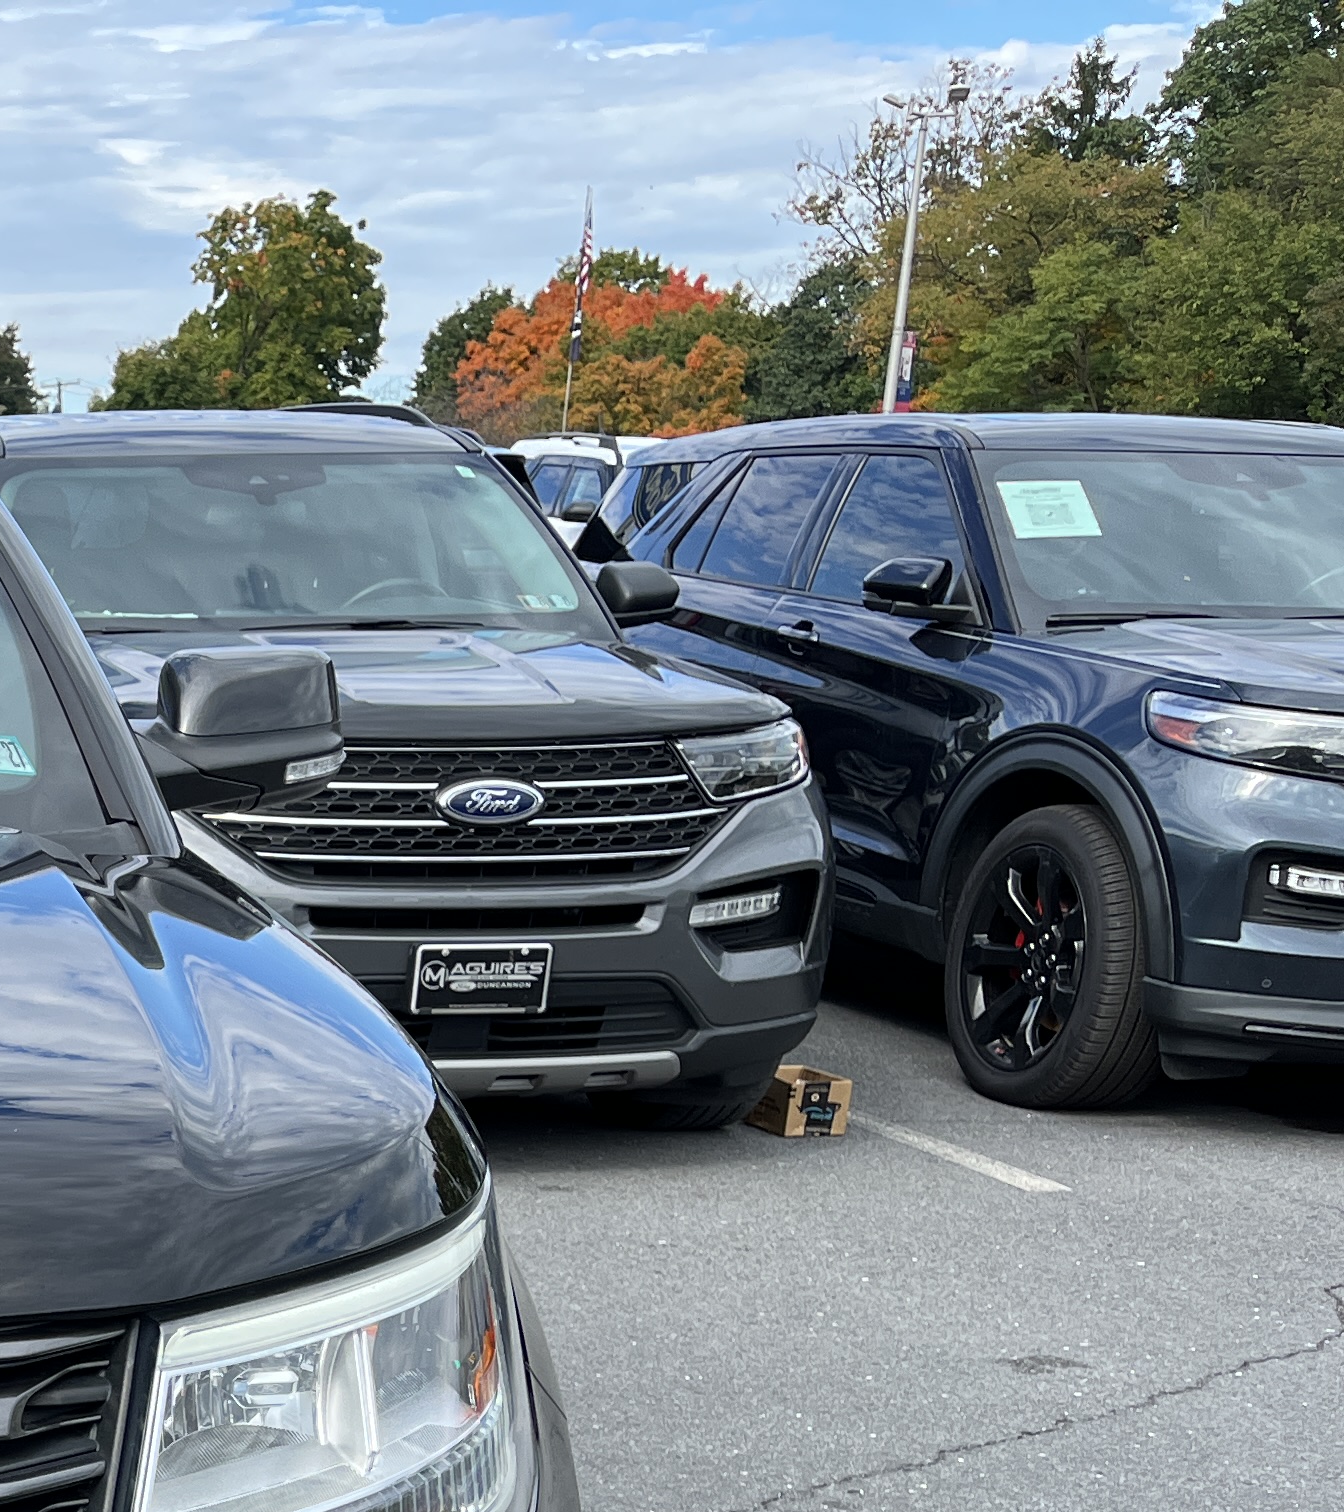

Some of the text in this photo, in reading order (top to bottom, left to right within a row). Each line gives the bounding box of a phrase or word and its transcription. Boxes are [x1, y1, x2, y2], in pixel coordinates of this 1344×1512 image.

[0, 740, 27, 770] 27
[465, 788, 522, 813] Ford
[476, 981, 532, 989] DUNCANNON
